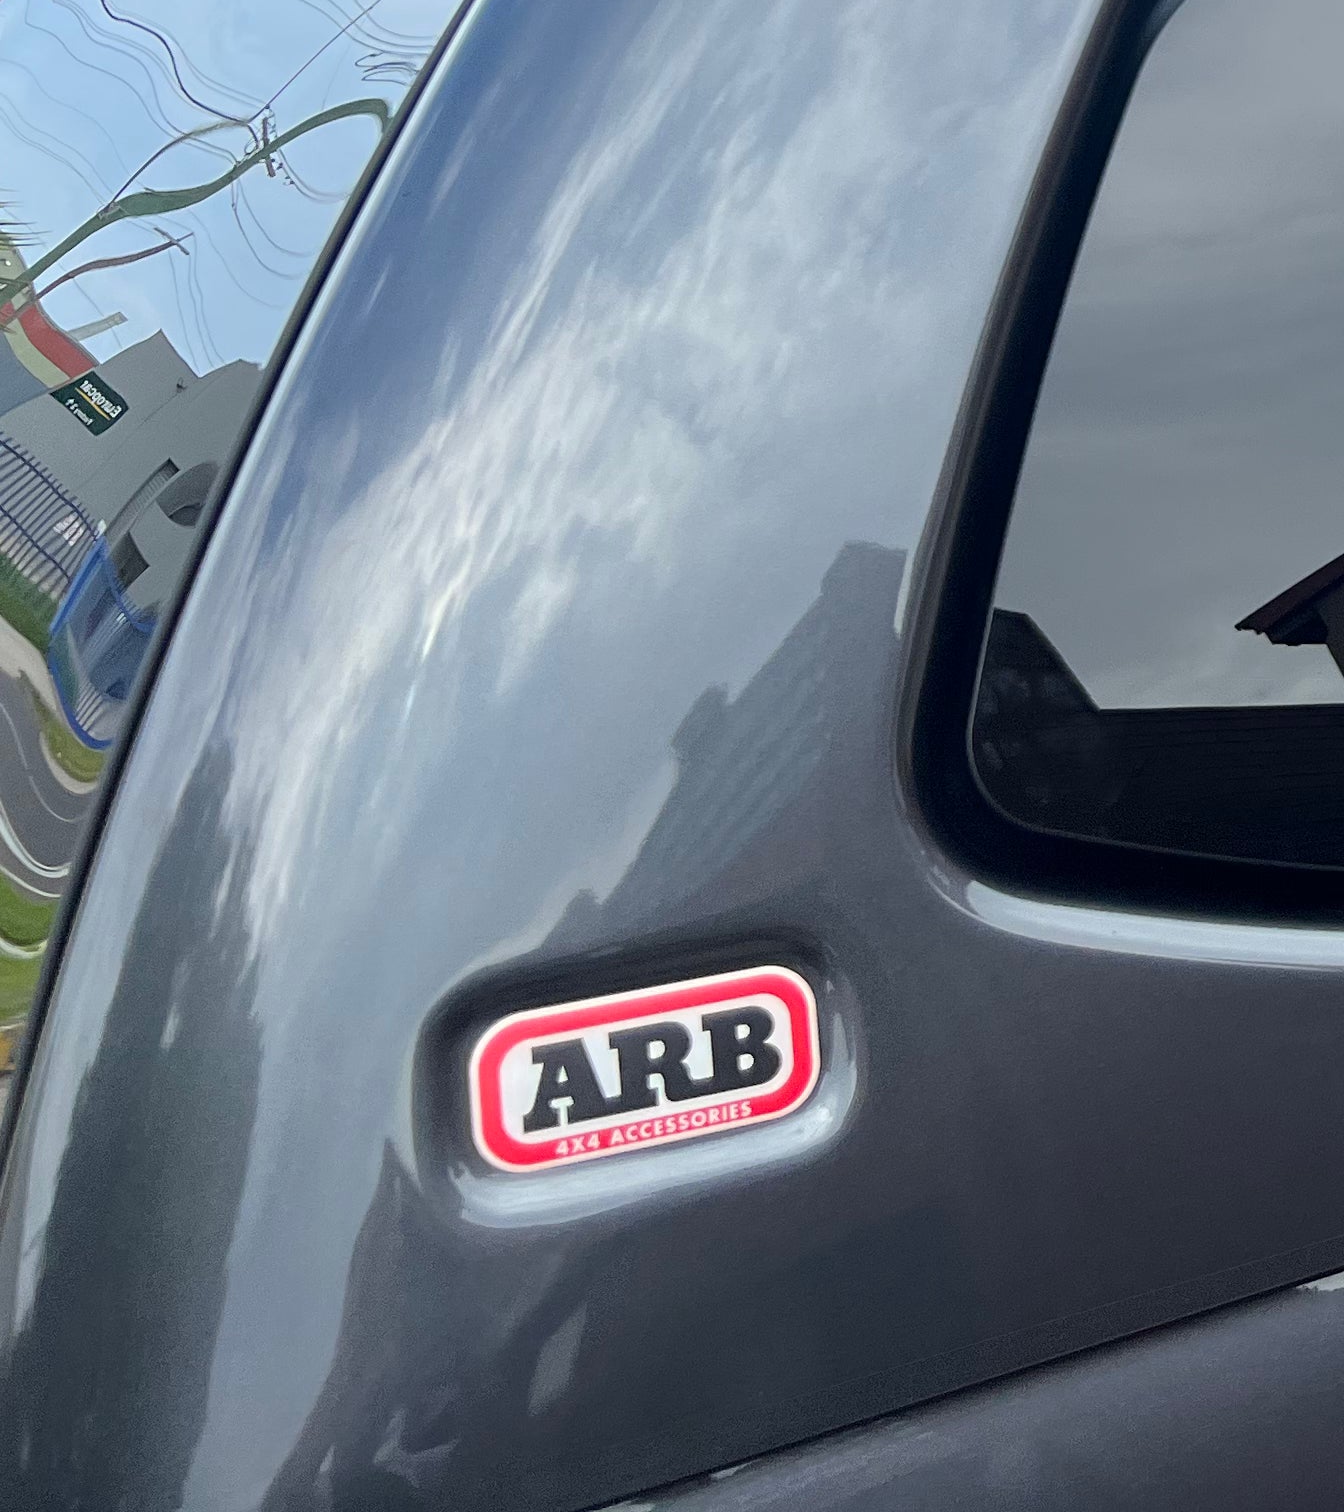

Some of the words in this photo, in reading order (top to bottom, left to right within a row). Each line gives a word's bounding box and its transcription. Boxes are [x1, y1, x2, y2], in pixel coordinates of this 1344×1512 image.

[523, 1005, 782, 1133] ARB
[556, 1133, 601, 1156] 4X4
[610, 1100, 752, 1144] ACCESSORIES
